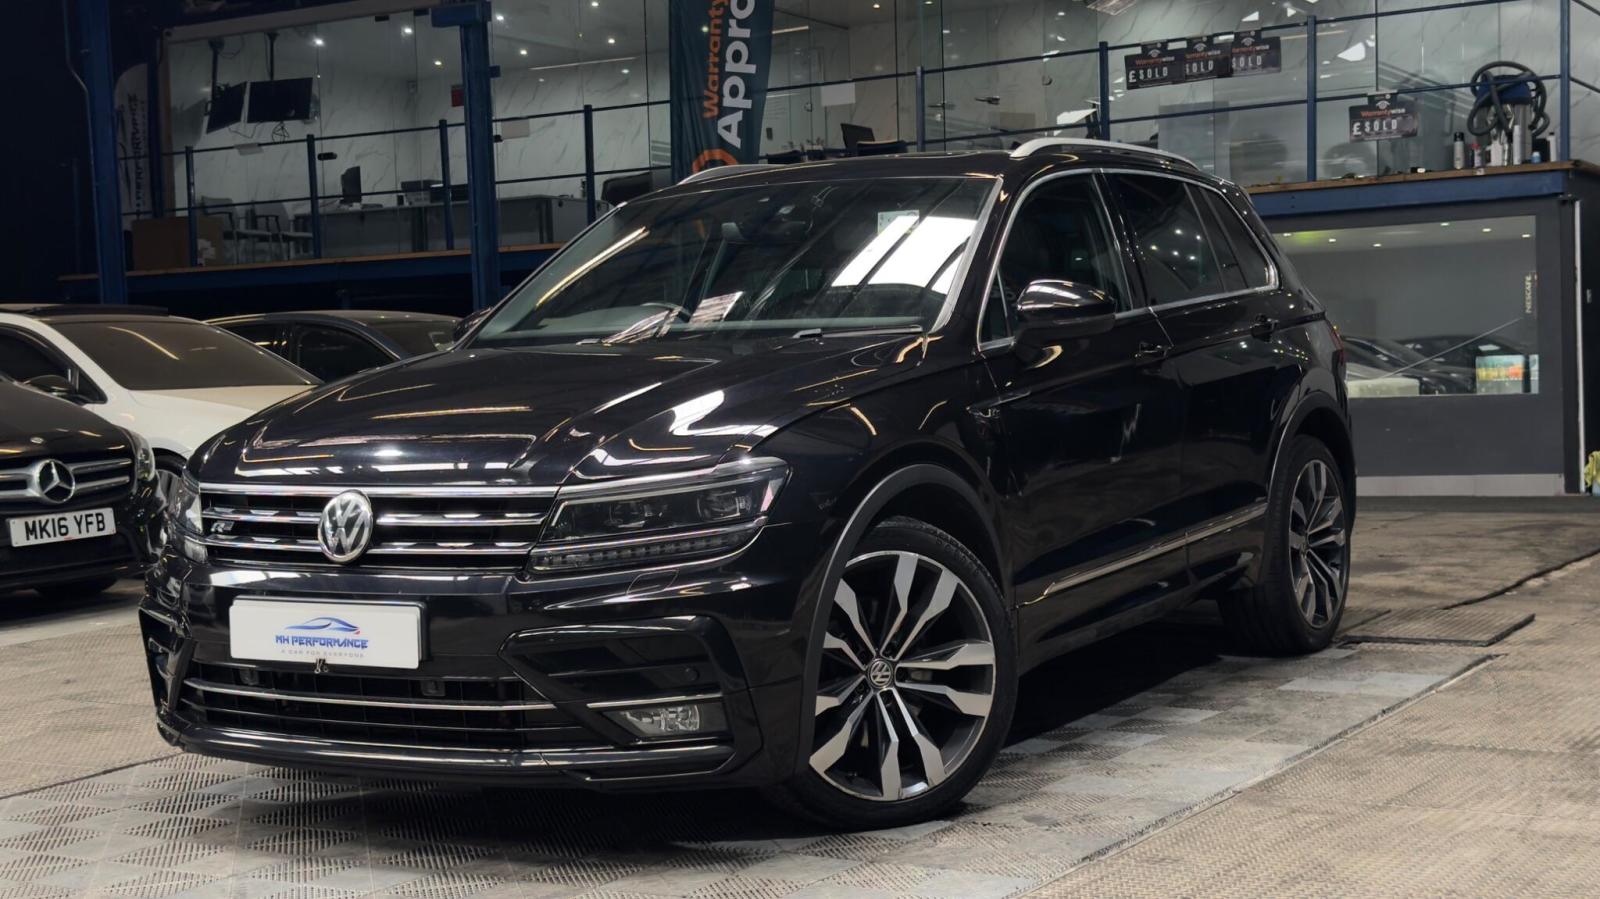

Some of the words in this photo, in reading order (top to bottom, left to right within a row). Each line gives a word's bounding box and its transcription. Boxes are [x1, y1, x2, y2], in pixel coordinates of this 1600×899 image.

[25, 517, 69, 541] MK16
[74, 513, 106, 535] YFB
[292, 636, 368, 650] PERFORMANCE
